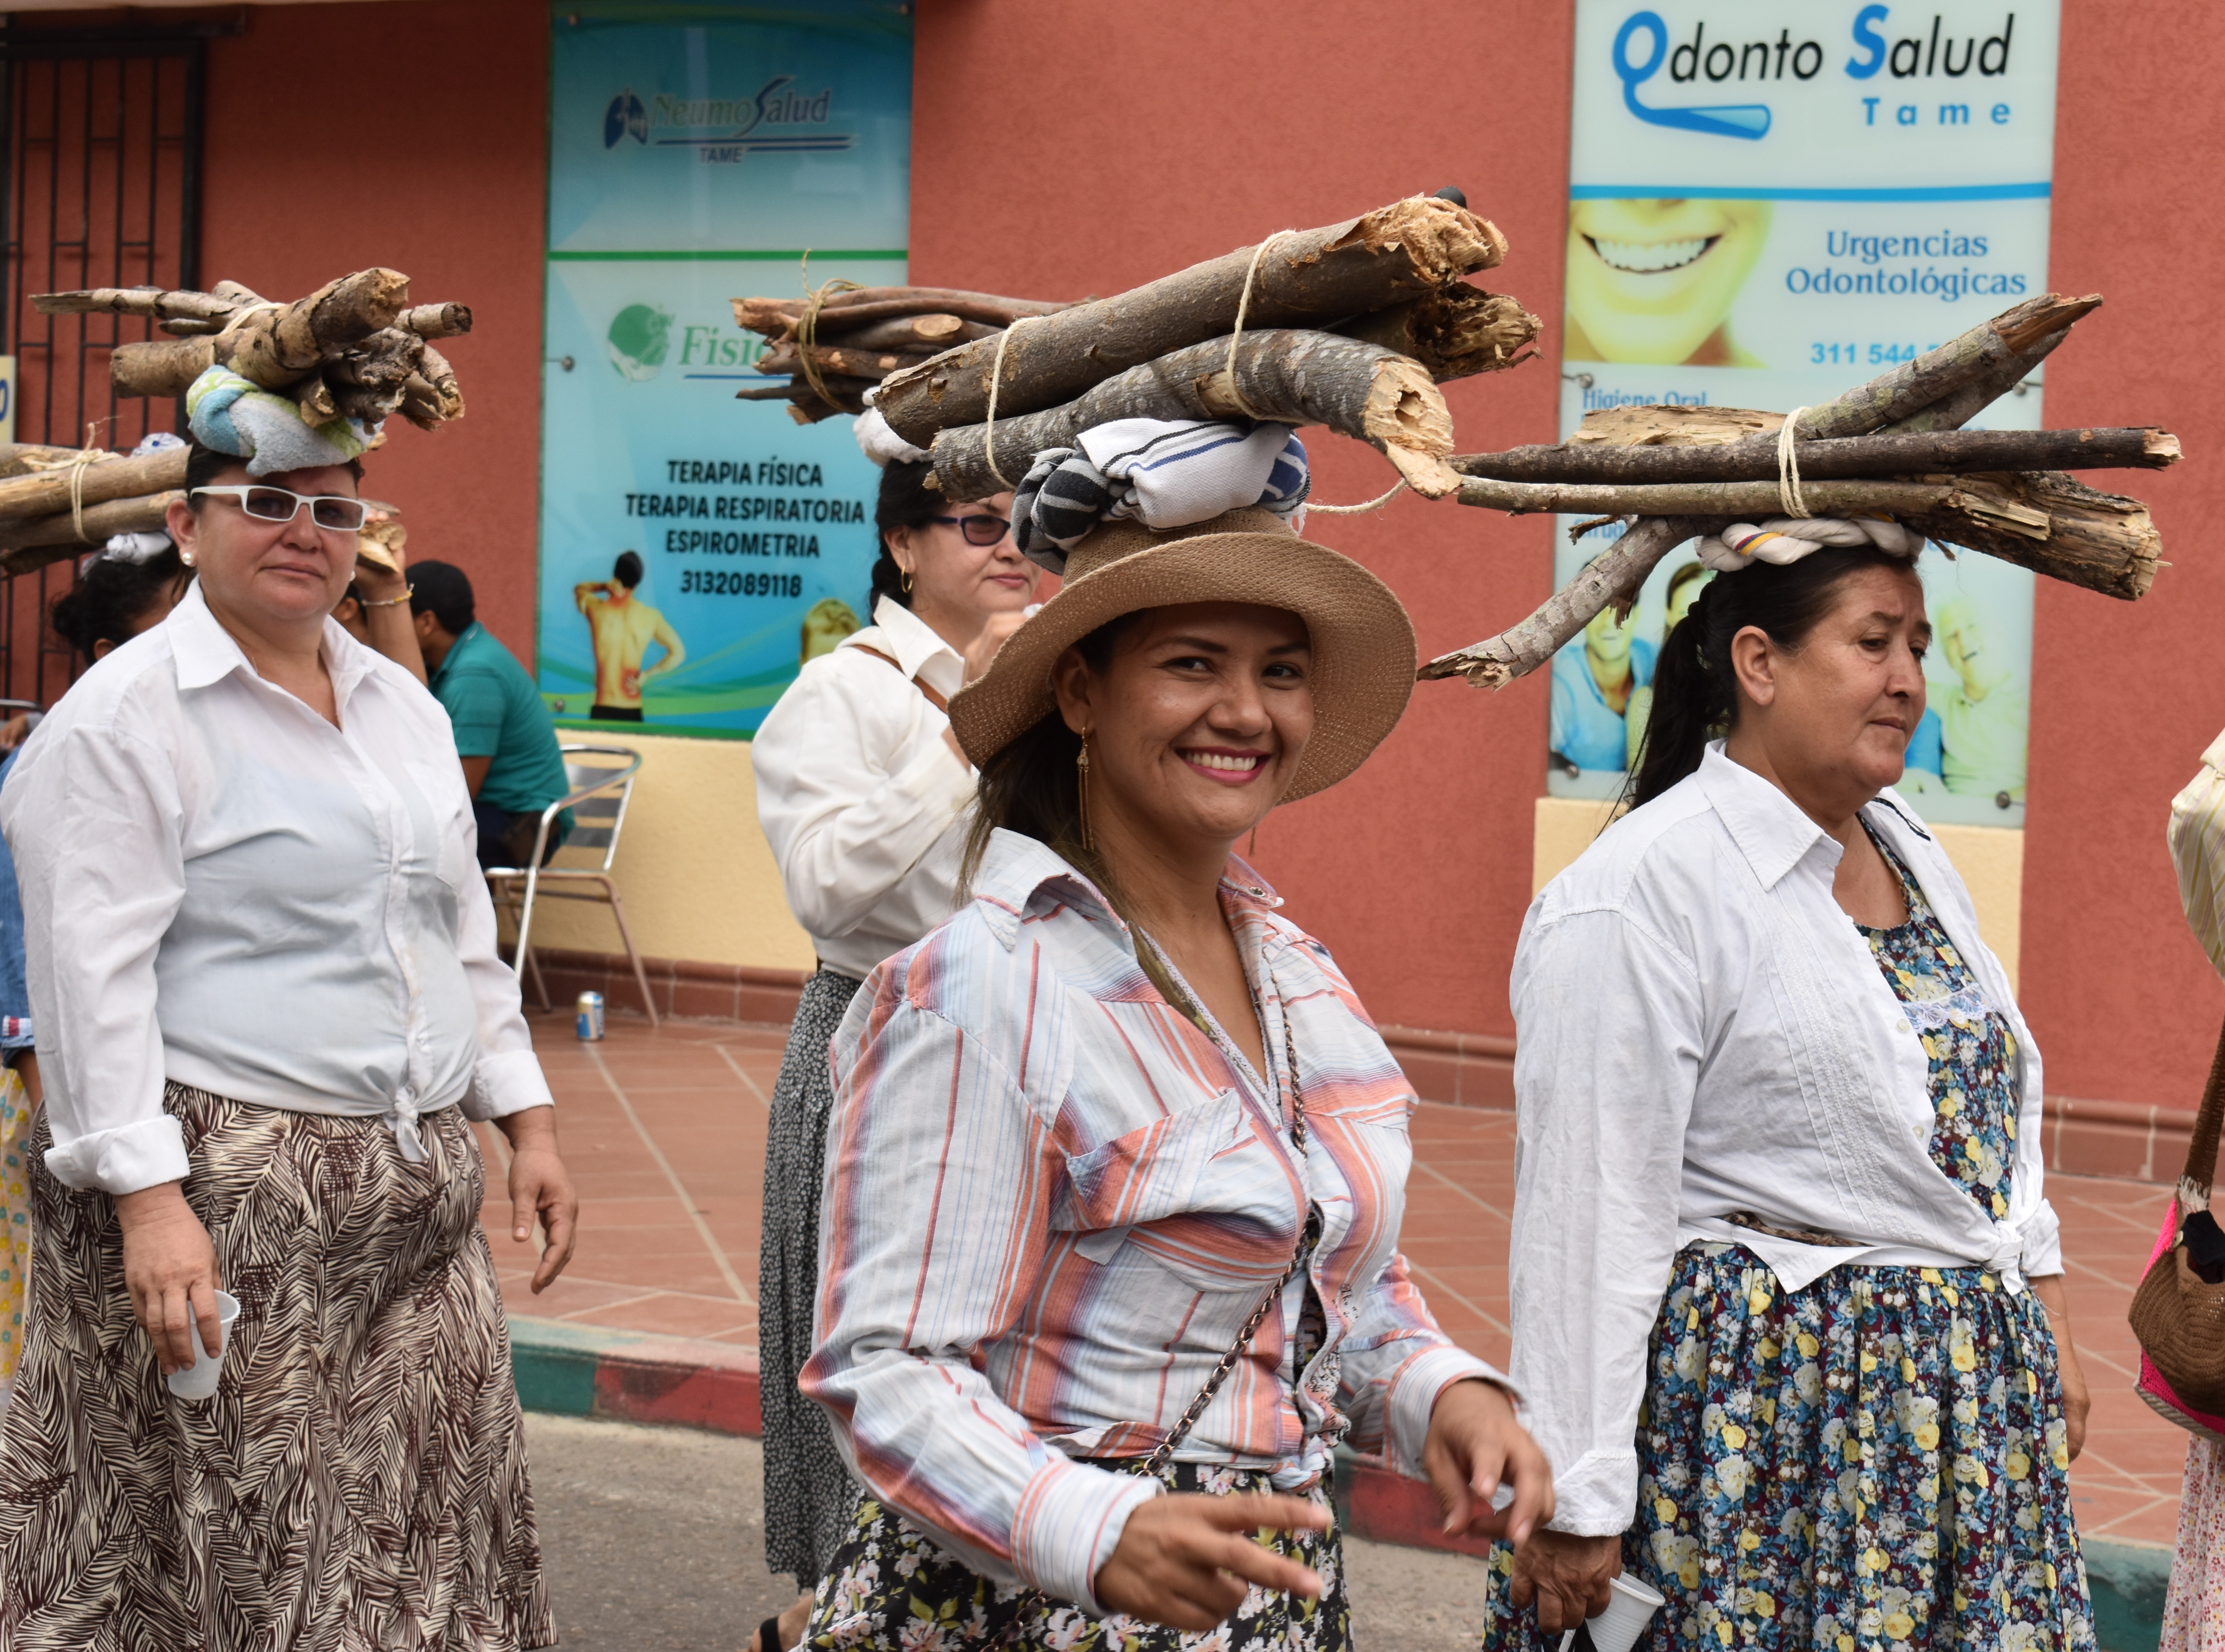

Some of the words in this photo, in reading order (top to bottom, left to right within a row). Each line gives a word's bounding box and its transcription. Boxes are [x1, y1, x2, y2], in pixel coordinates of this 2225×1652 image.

[1613, 11, 1823, 84] Odonto
[1844, 4, 2014, 79] Salud
[654, 76, 830, 137] NeumoSalud
[1862, 98, 2011, 126] Tame
[701, 148, 743, 163] TAME
[1827, 229, 1988, 265] Urgencias
[1786, 266, 2026, 303] Odontológicas
[1811, 343, 1856, 364] 311
[1868, 344, 1916, 365] 544
[1583, 389, 1656, 409] Higiene
[1664, 391, 1707, 406] Oral
[668, 460, 752, 485] TERAPIA
[757, 456, 823, 487] FÍSICA
[625, 494, 709, 519] TERAPIA
[715, 496, 865, 524] RESPIRATORIA
[666, 530, 820, 558] ESPIROMETRIA
[680, 570, 802, 598] 3132089118
